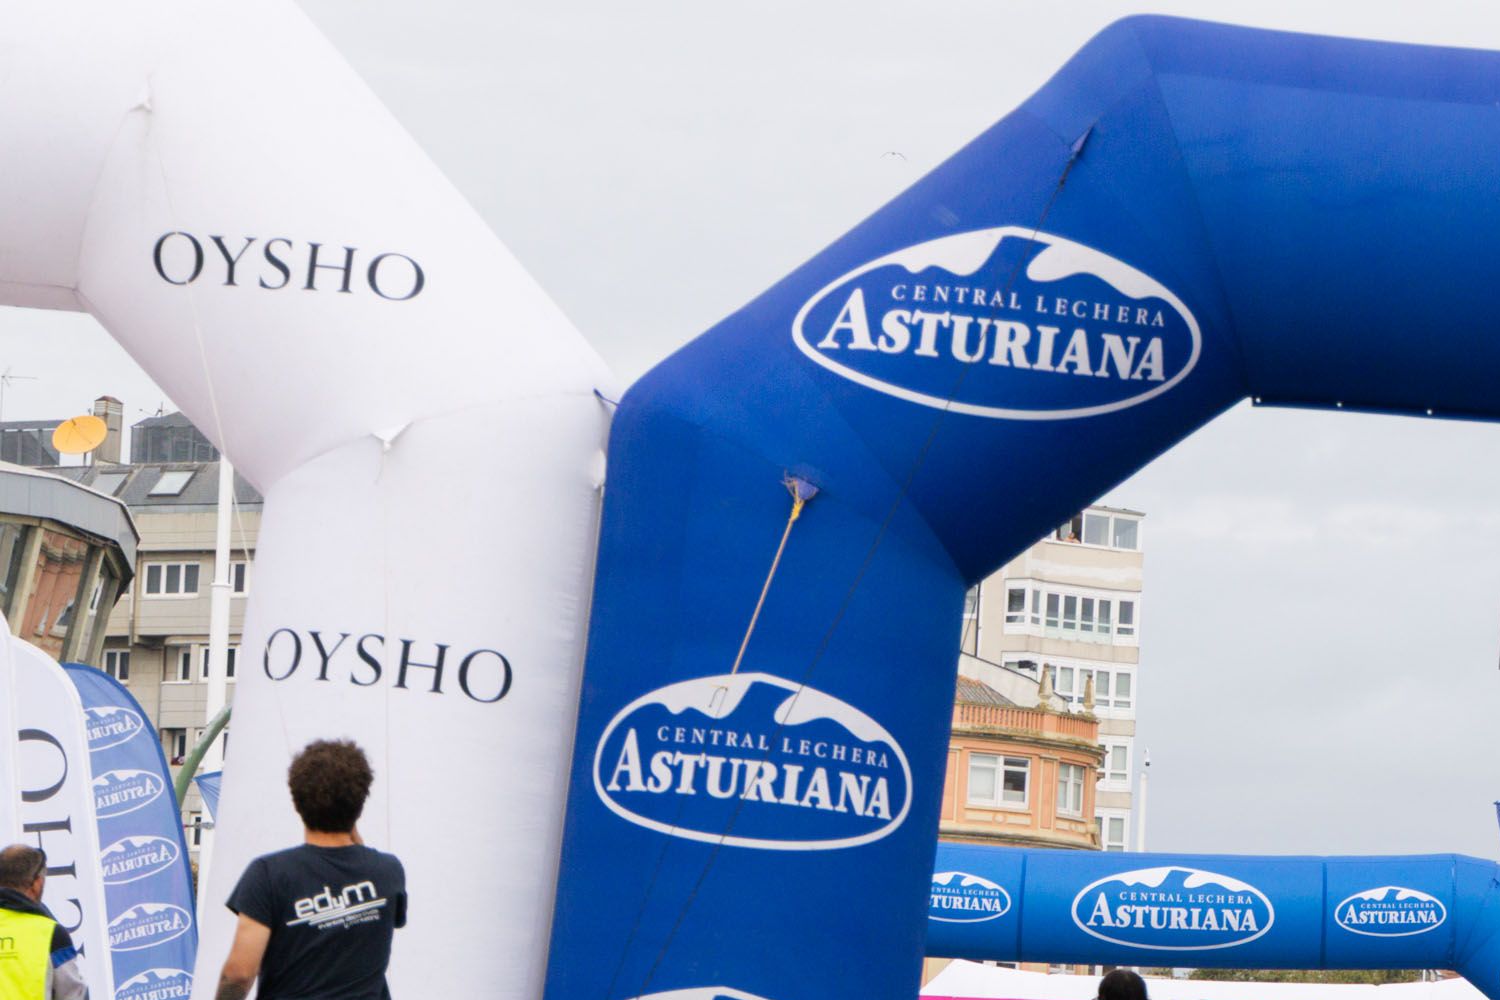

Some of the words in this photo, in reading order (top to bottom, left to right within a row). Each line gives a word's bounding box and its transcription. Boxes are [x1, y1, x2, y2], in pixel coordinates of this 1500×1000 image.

[152, 231, 425, 301] OYSHO
[891, 284, 1021, 311] CENTRAL
[1036, 294, 1166, 328] LECHERA
[818, 287, 1166, 382] ASTURIANA
[263, 628, 514, 704] OYSHO
[657, 724, 769, 751] CENTRAL
[782, 735, 889, 768] LECHERA
[607, 727, 891, 820] ASTURIANA
[930, 894, 1002, 912] TURIANA
[931, 887, 960, 895] ENTRAL
[1087, 892, 1259, 932] ASTURIANA
[1119, 891, 1182, 903] CENTRAL
[1189, 893, 1253, 905] LECHERA
[1343, 904, 1438, 924] ASTURIANA
